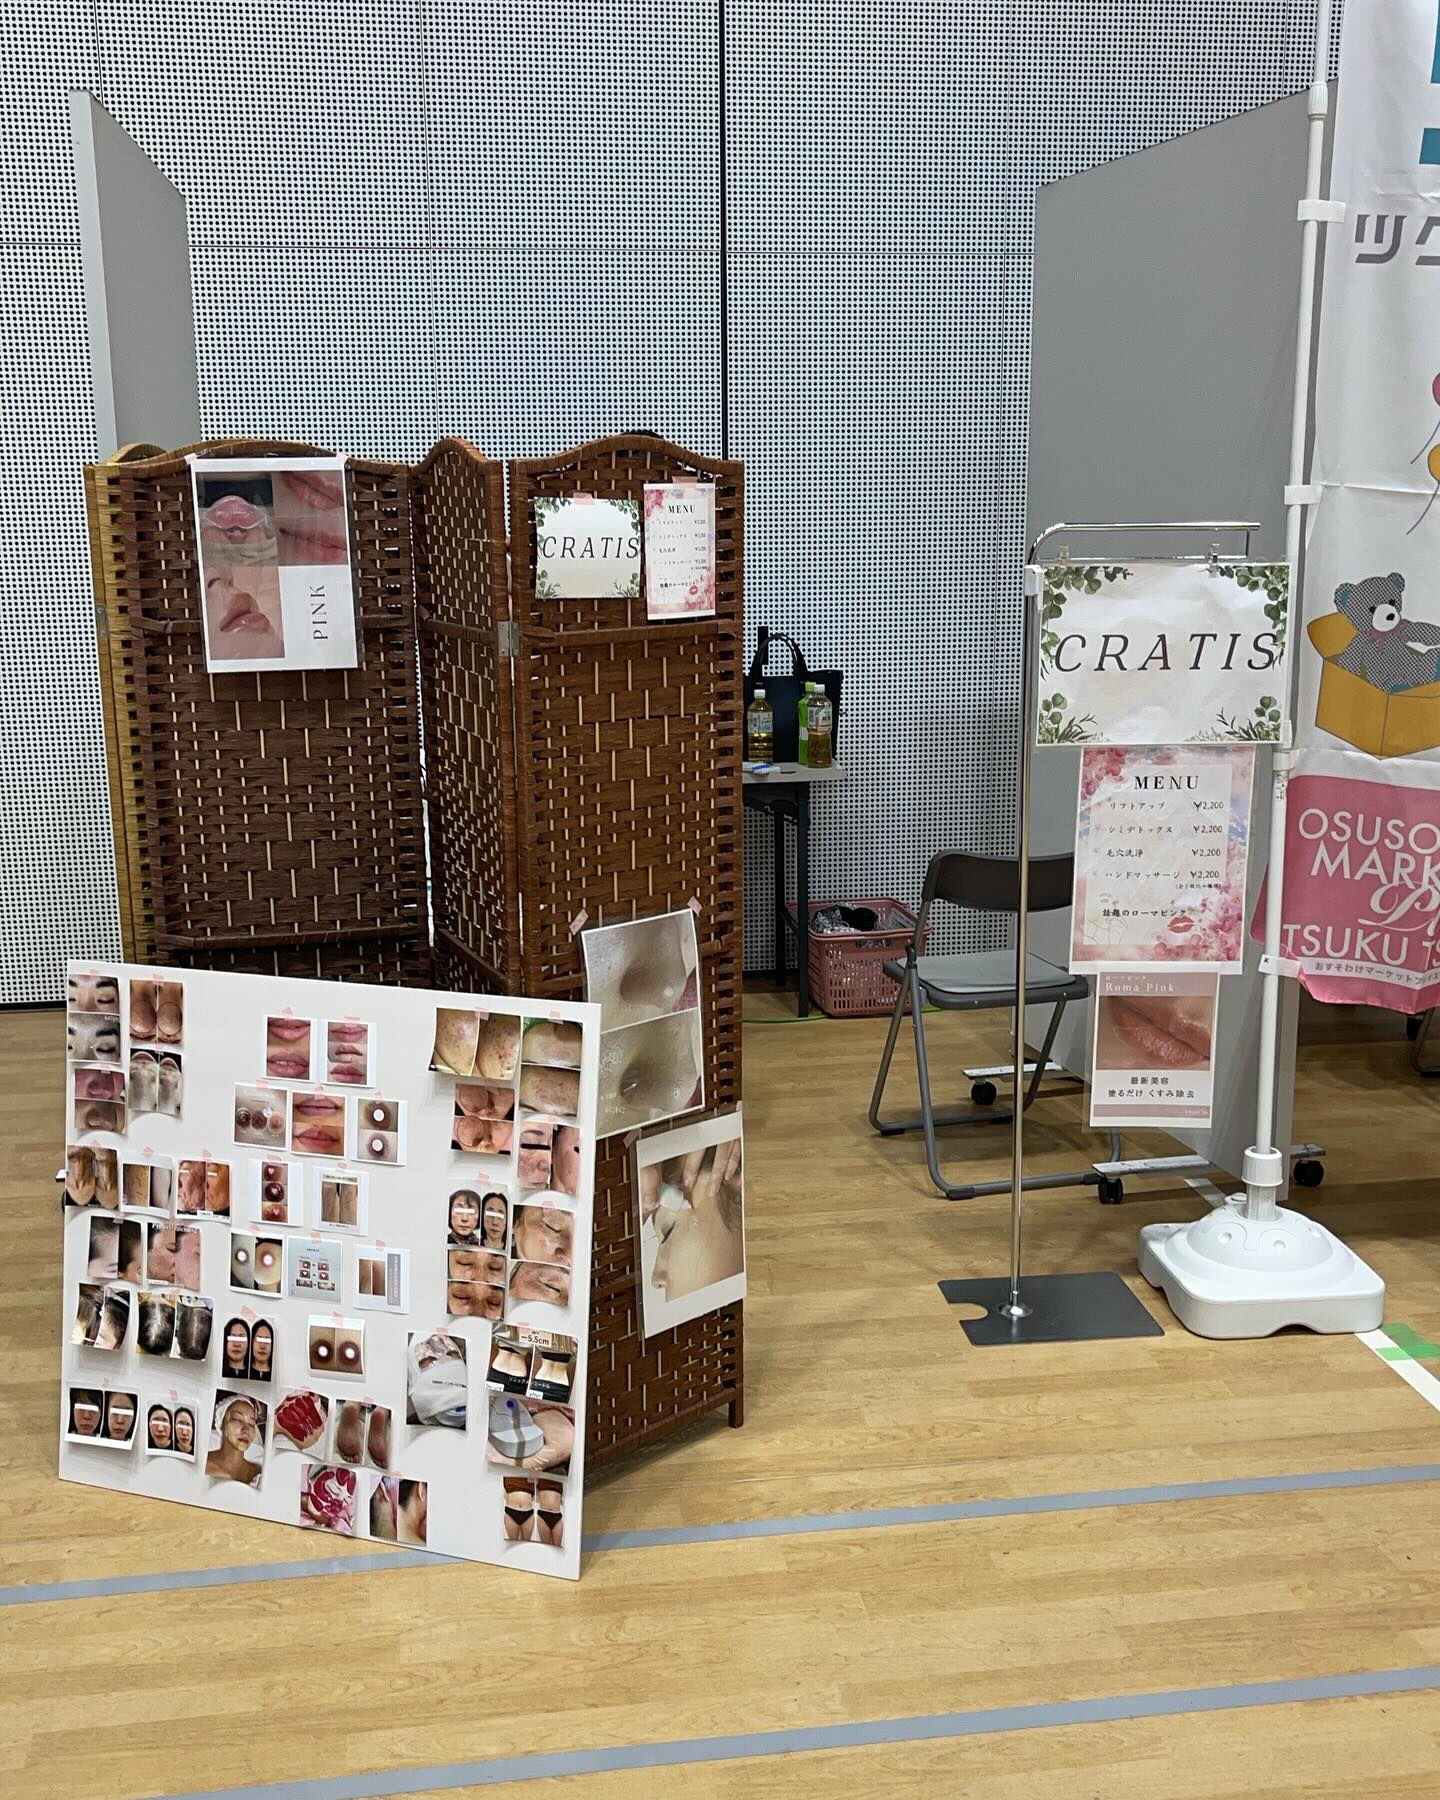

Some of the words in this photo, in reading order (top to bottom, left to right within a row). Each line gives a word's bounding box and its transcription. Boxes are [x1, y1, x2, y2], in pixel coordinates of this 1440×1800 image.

[668, 504, 696, 514] MENU
[543, 536, 639, 559] CRATIS
[309, 585, 328, 639] PINK
[1055, 632, 1278, 672] CRATIS
[1134, 775, 1199, 790] MENU
[1106, 849, 1144, 858] 毛穴洗浄
[1283, 924, 1409, 966] TSUKU
[1105, 982, 1139, 992] Roma
[1146, 982, 1175, 992] Pink
[1130, 1076, 1169, 1085] 最新美容
[1108, 1089, 1143, 1098] 塗るだけ
